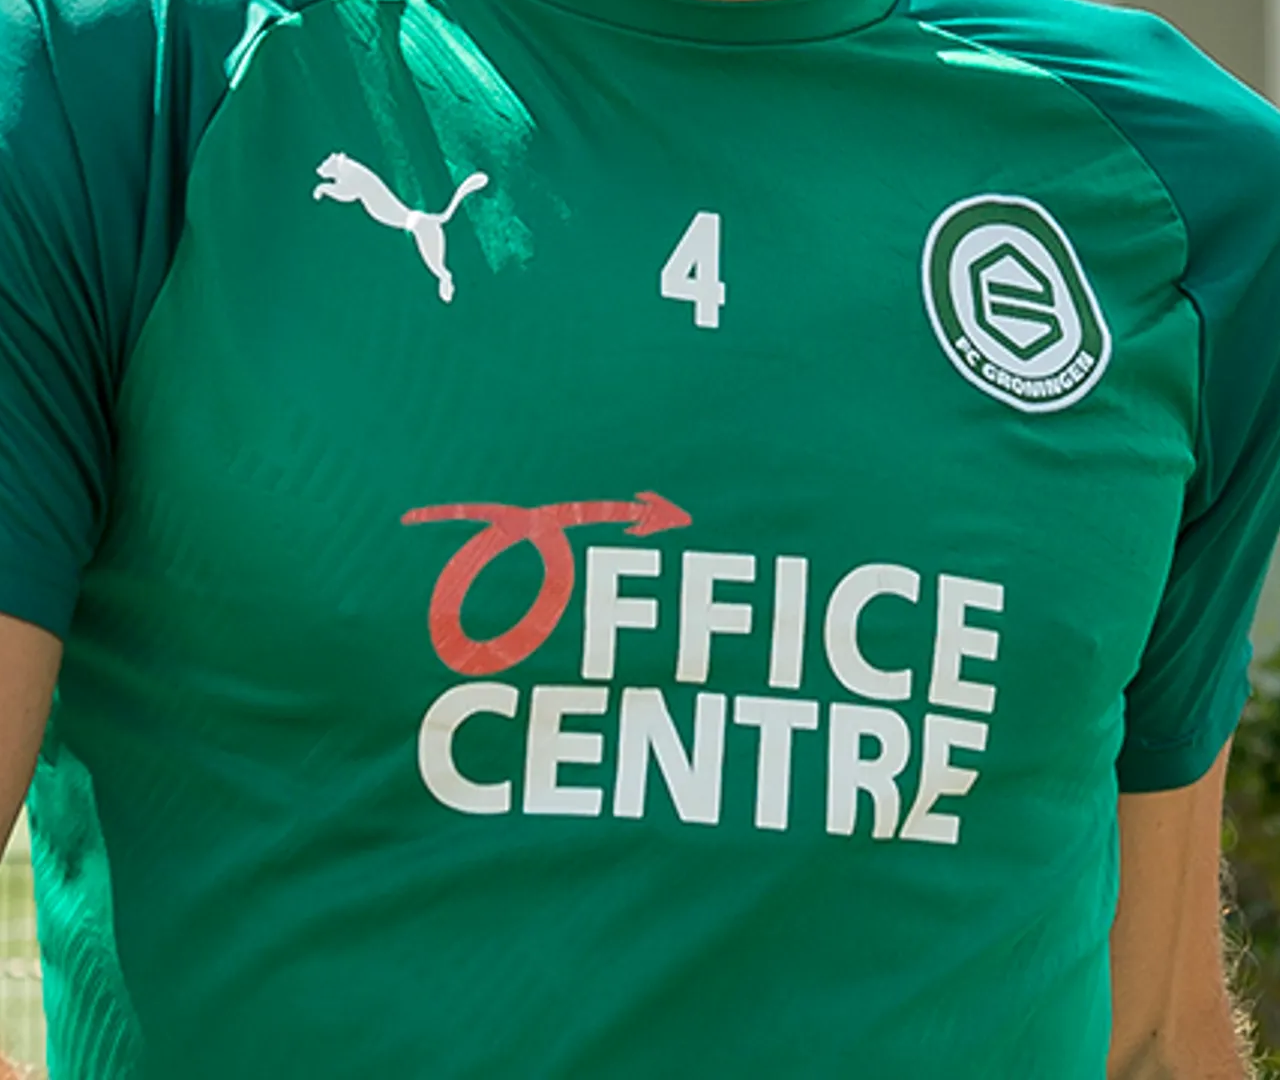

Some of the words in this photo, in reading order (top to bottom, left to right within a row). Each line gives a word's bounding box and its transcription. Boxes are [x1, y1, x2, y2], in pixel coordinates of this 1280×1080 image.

[661, 212, 725, 328] 4
[955, 336, 981, 367] FC
[982, 350, 1095, 398] GRONINGEN
[403, 493, 1004, 713] OFFICE
[418, 682, 989, 844] CENTRE
